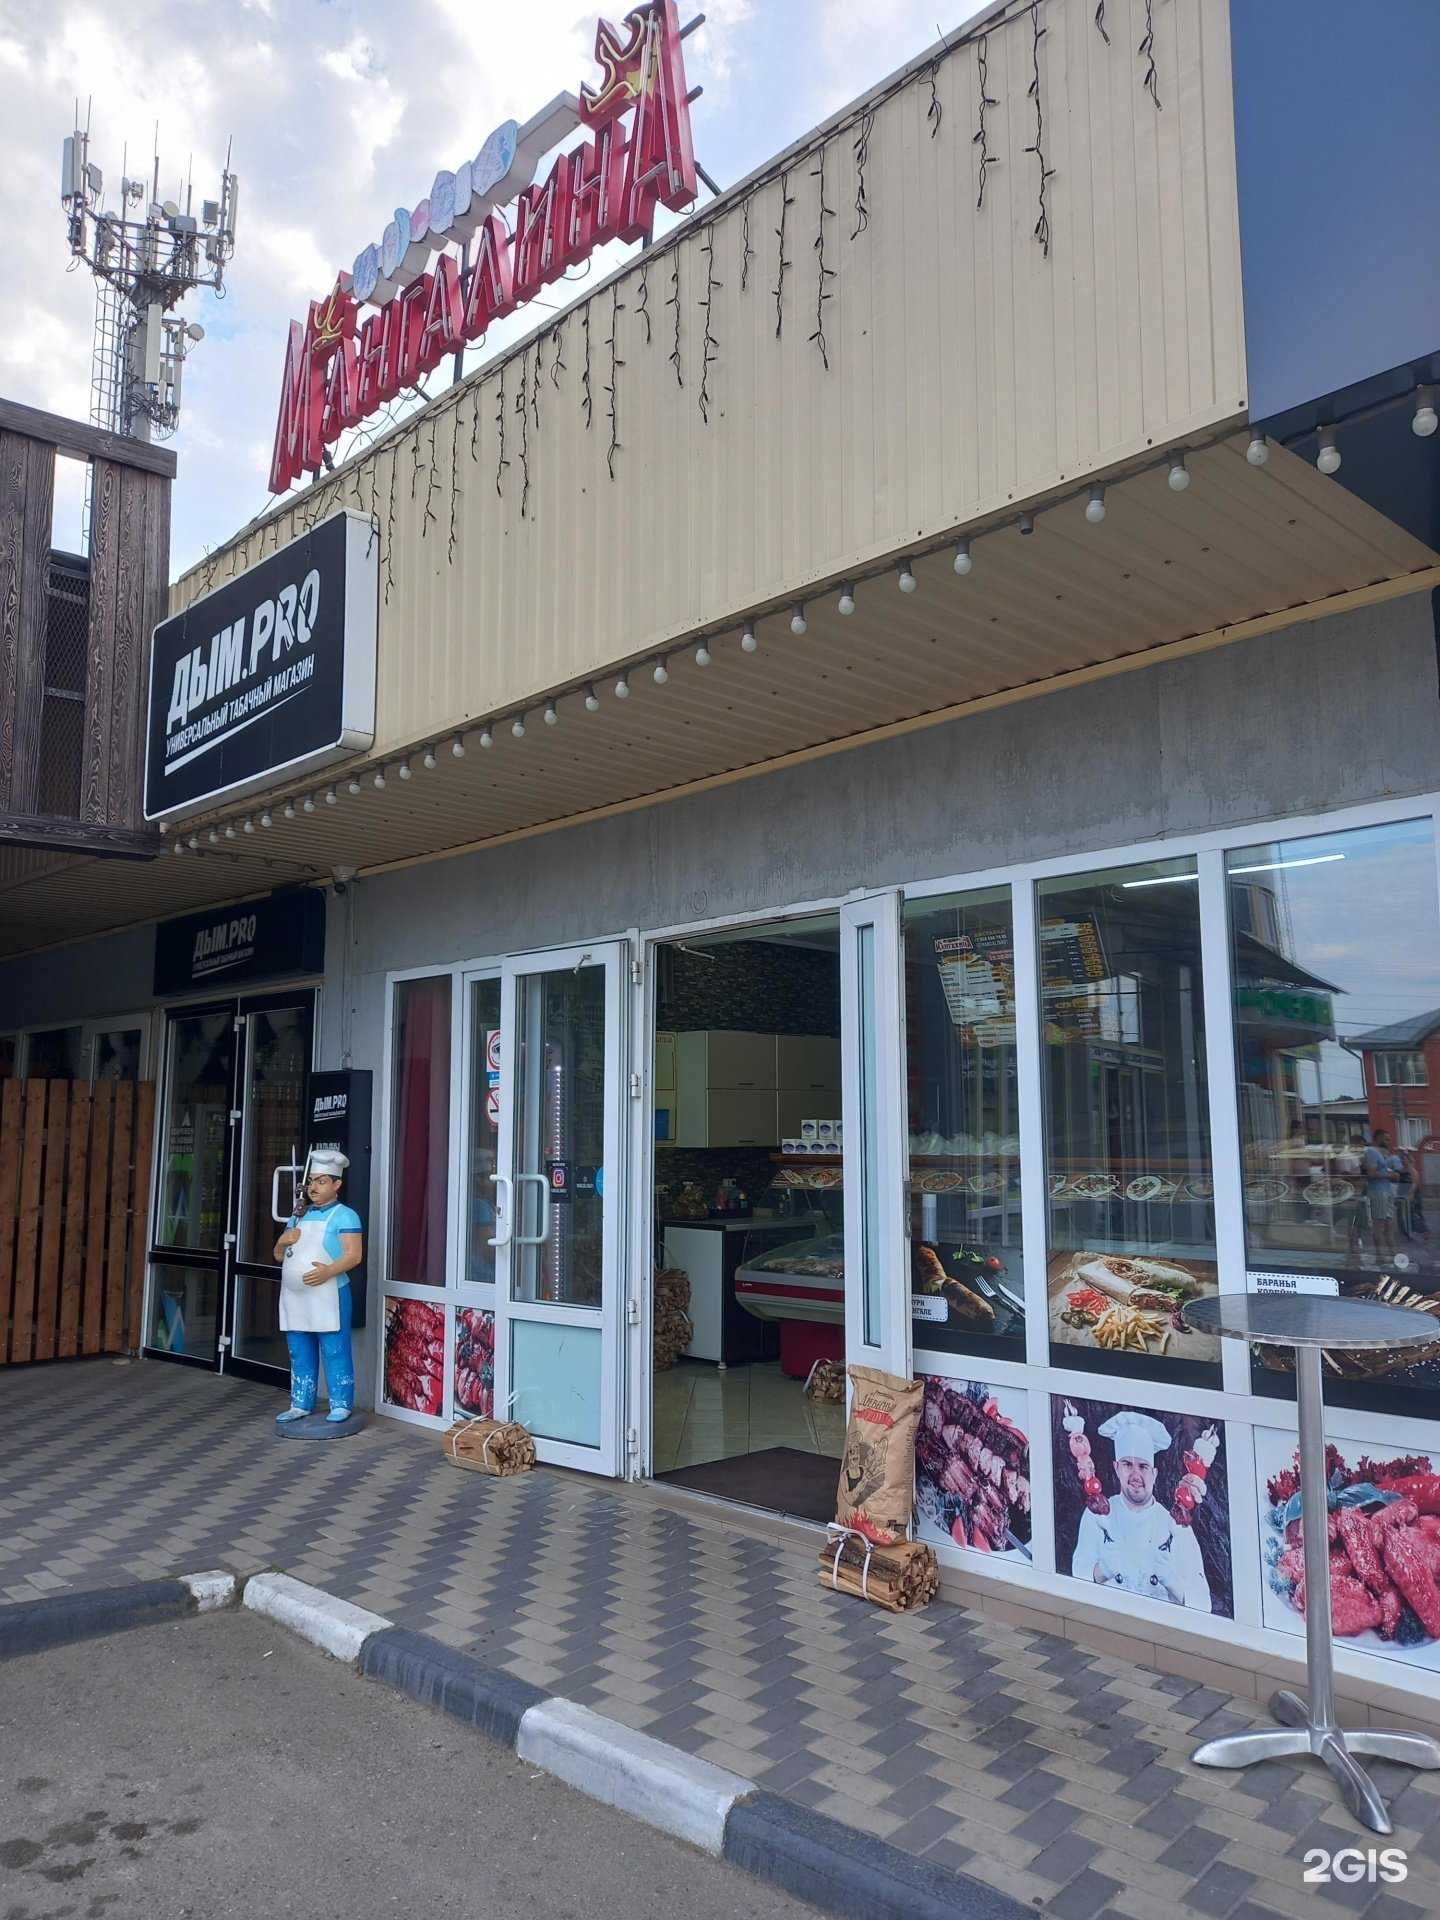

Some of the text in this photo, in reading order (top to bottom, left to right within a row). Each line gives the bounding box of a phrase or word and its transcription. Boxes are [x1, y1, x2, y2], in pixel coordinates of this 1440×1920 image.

[268, 0, 698, 495] МАНГАЛИНА
[166, 653, 315, 758] УНИВЕРСАЛЬНЫЙ ТАБАЧНЫЙ МАГАЗИН
[1257, 1278, 1297, 1288] БАРАНЬЯ
